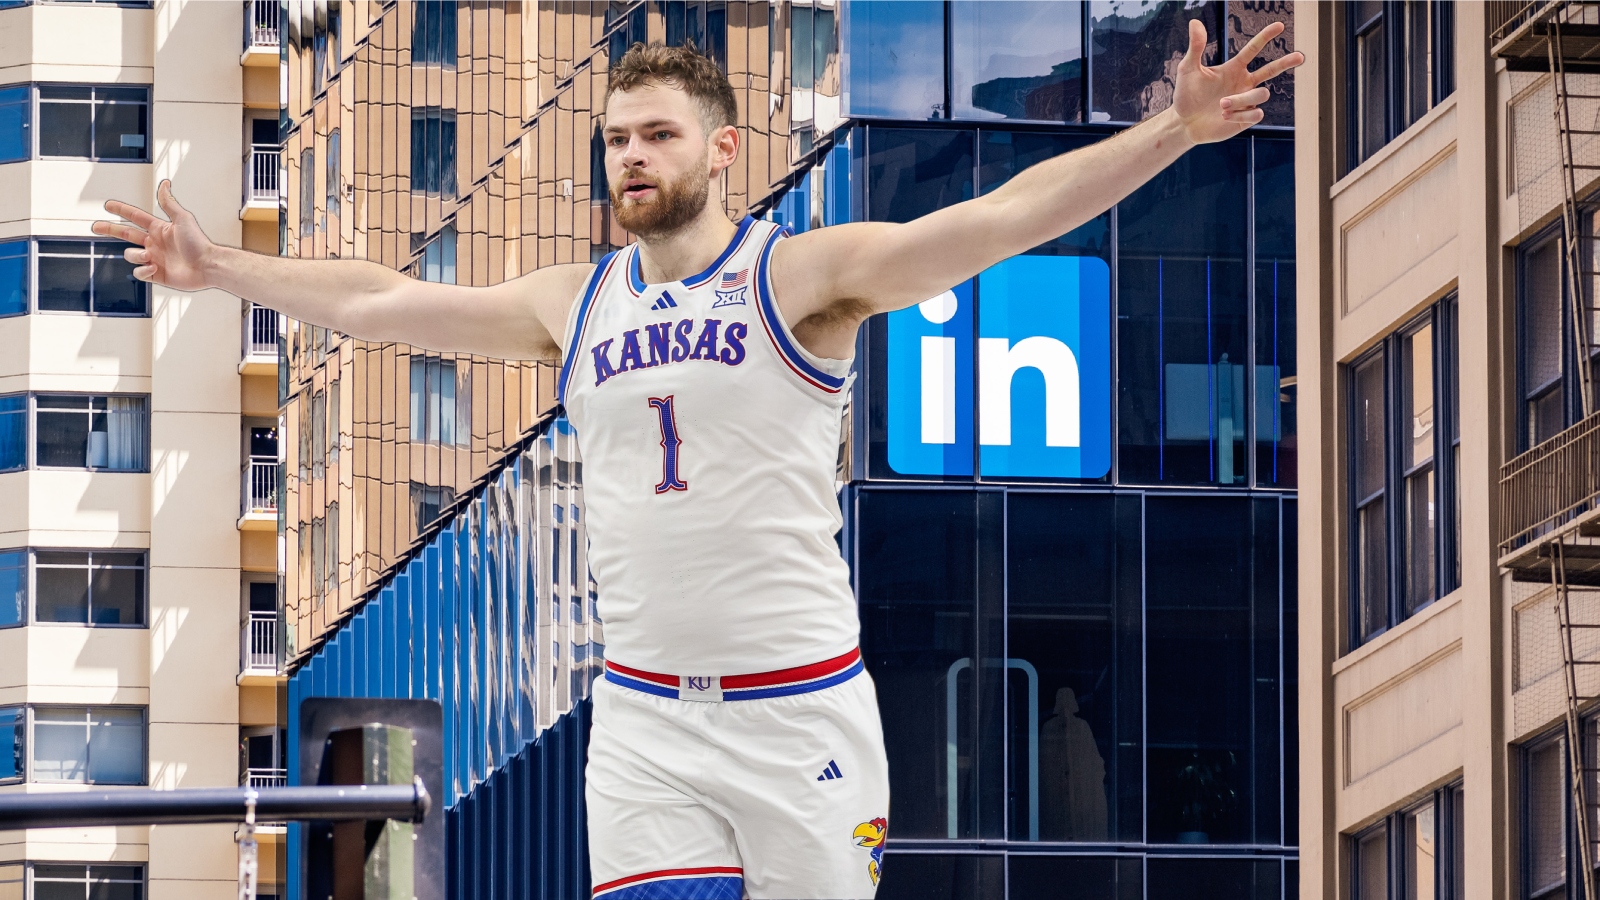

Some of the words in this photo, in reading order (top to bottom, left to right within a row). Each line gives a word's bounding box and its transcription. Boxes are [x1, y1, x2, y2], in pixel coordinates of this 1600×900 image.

[712, 285, 748, 309] XII
[591, 318, 748, 387] KANSAS
[918, 289, 1080, 447] in
[648, 395, 687, 494] 1
[688, 676, 711, 691] KU
